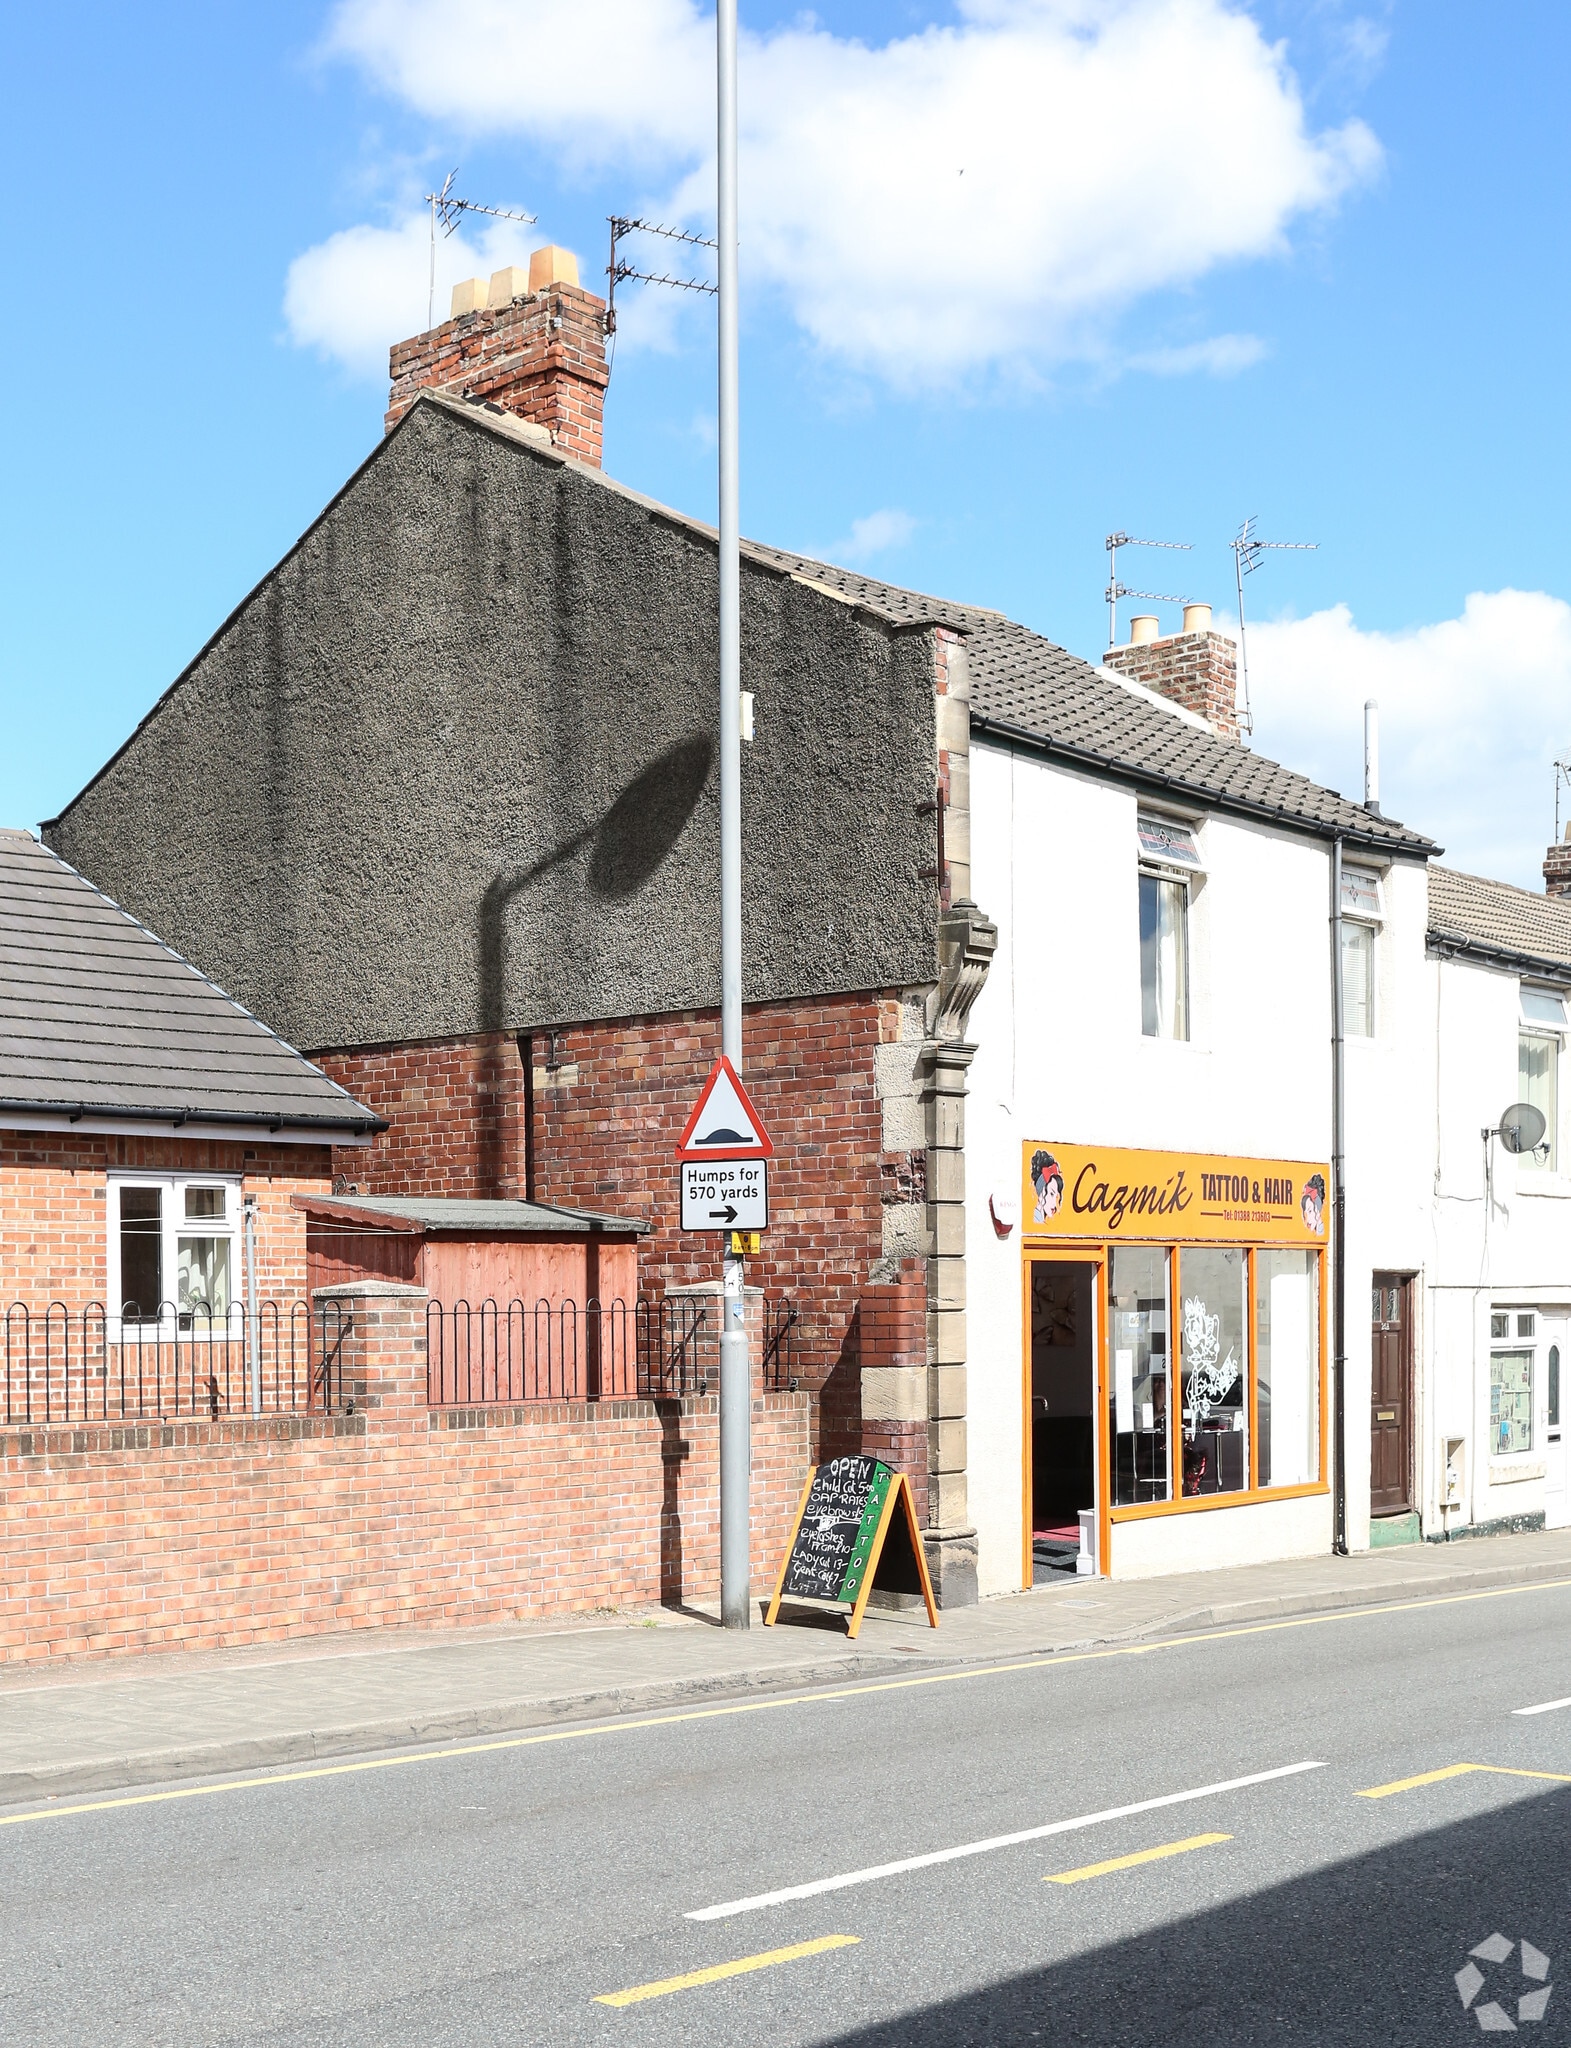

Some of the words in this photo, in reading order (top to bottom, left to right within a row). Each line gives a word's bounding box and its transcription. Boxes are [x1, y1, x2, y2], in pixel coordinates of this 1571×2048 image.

[687, 1170, 735, 1184] Humps
[740, 1167, 760, 1181] for
[689, 1186, 716, 1200] 570
[721, 1185, 759, 1202] yards
[1072, 1163, 1193, 1230] Cazmik
[1201, 1173, 1249, 1203] TATTOO
[1252, 1181, 1261, 1204] &
[1264, 1178, 1293, 1206] HAIR
[1223, 1209, 1233, 1221] Tel:
[1234, 1209, 1250, 1222] 01388
[830, 1457, 871, 1480] OPEN
[813, 1478, 841, 1493] Child
[810, 1492, 839, 1503] OAP
[839, 1493, 869, 1508] RATES
[792, 1547, 820, 1568] LADY
